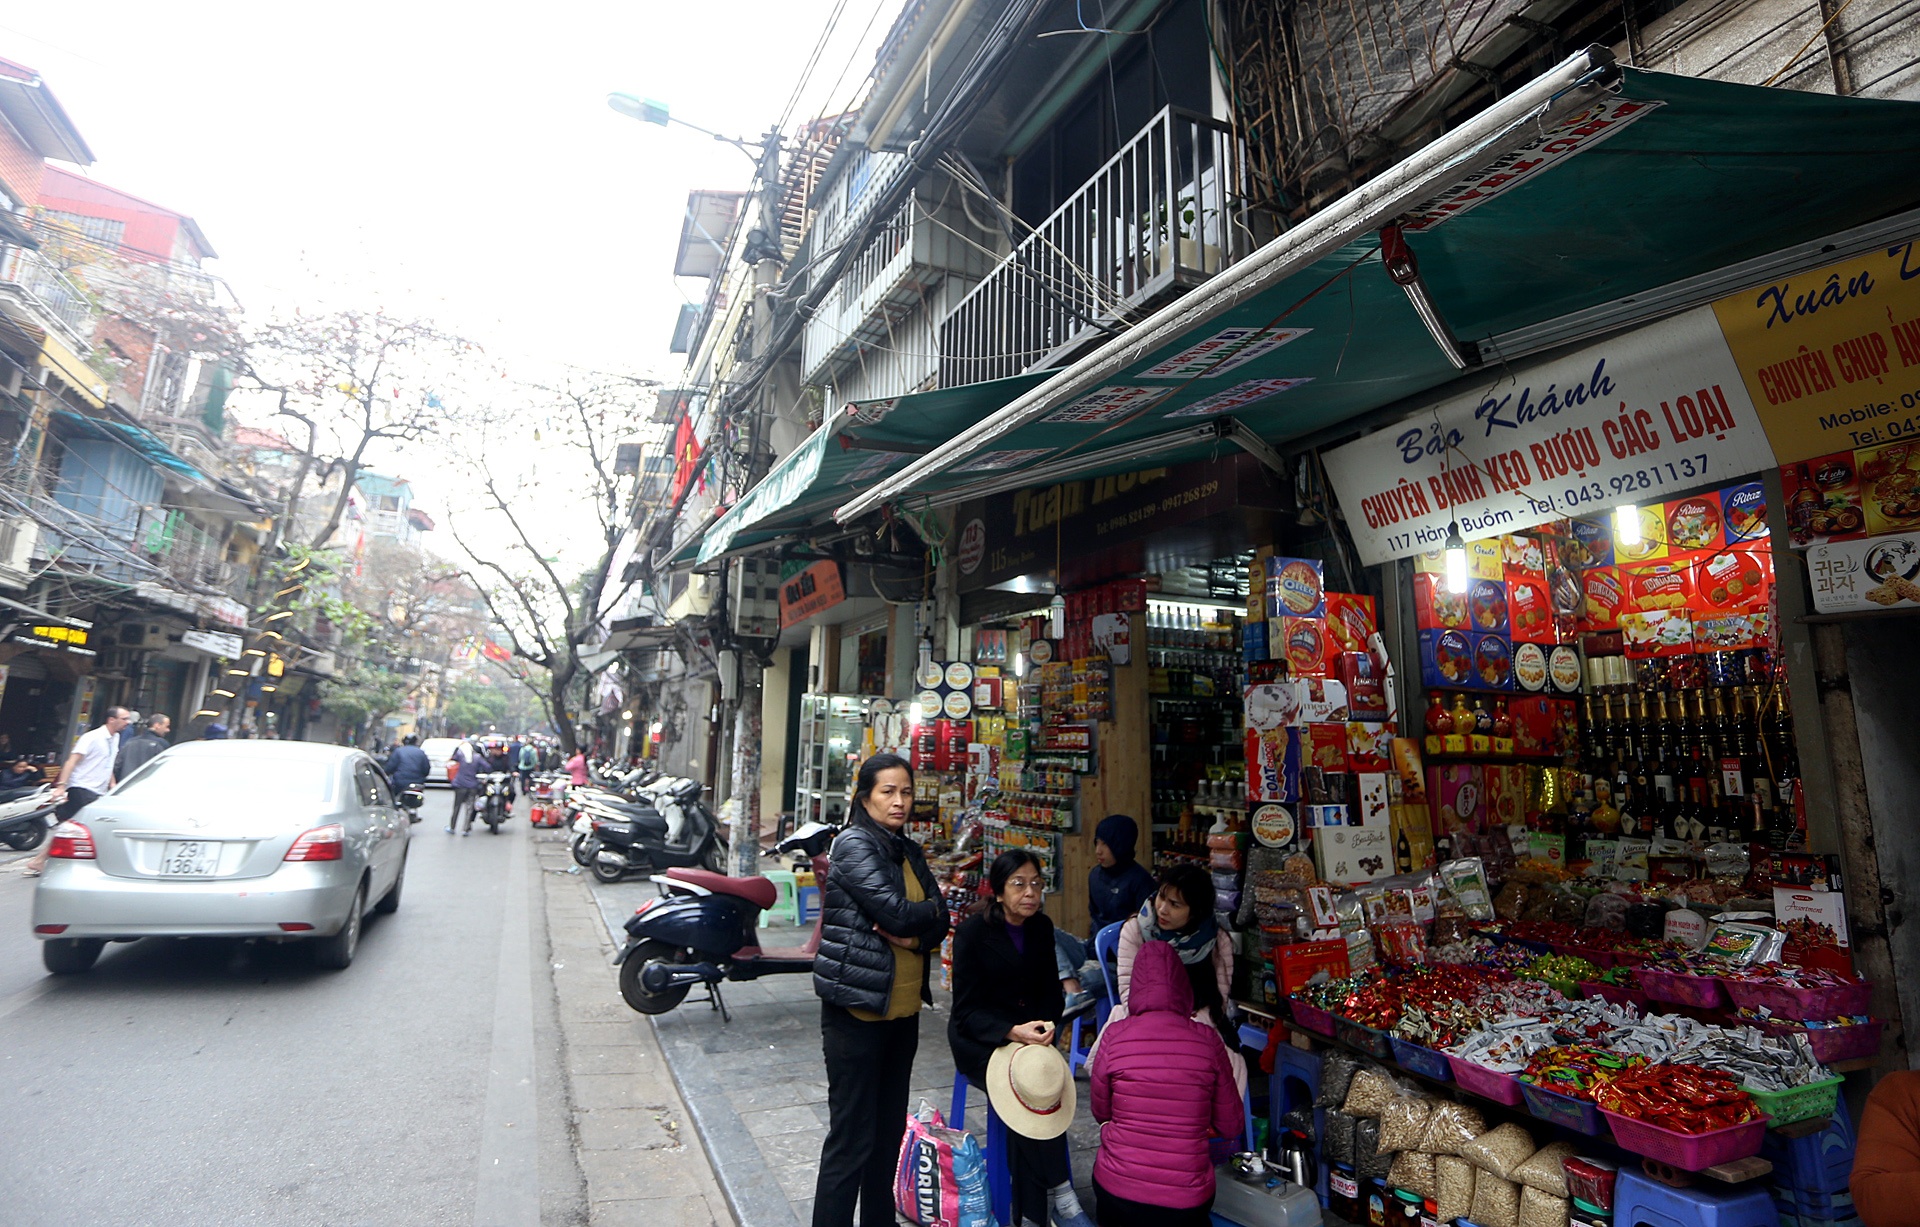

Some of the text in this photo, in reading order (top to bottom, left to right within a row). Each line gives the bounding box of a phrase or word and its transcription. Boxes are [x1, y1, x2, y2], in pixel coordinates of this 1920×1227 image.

[1756, 270, 1875, 329] Xuân
[1758, 345, 1837, 406] CHUYÊN
[1832, 331, 1889, 385] CHỤP
[1396, 358, 1616, 464] Bảo Khánh
[1818, 400, 1898, 430] Mobile:
[1849, 426, 1884, 446] Tel:
[1361, 384, 1737, 529] CHUYÊN BÁNH KẸO RƯỢU CÁC LOẠI
[1183, 487, 1200, 504] 268
[1200, 480, 1218, 497] 299
[1732, 491, 1762, 507] Ritaz
[1387, 534, 1411, 552] 117
[1460, 507, 1514, 533] Buồm
[1263, 766, 1279, 791] OAT
[1785, 901, 1823, 913] Assortment
[918, 1143, 936, 1222] FORUM
